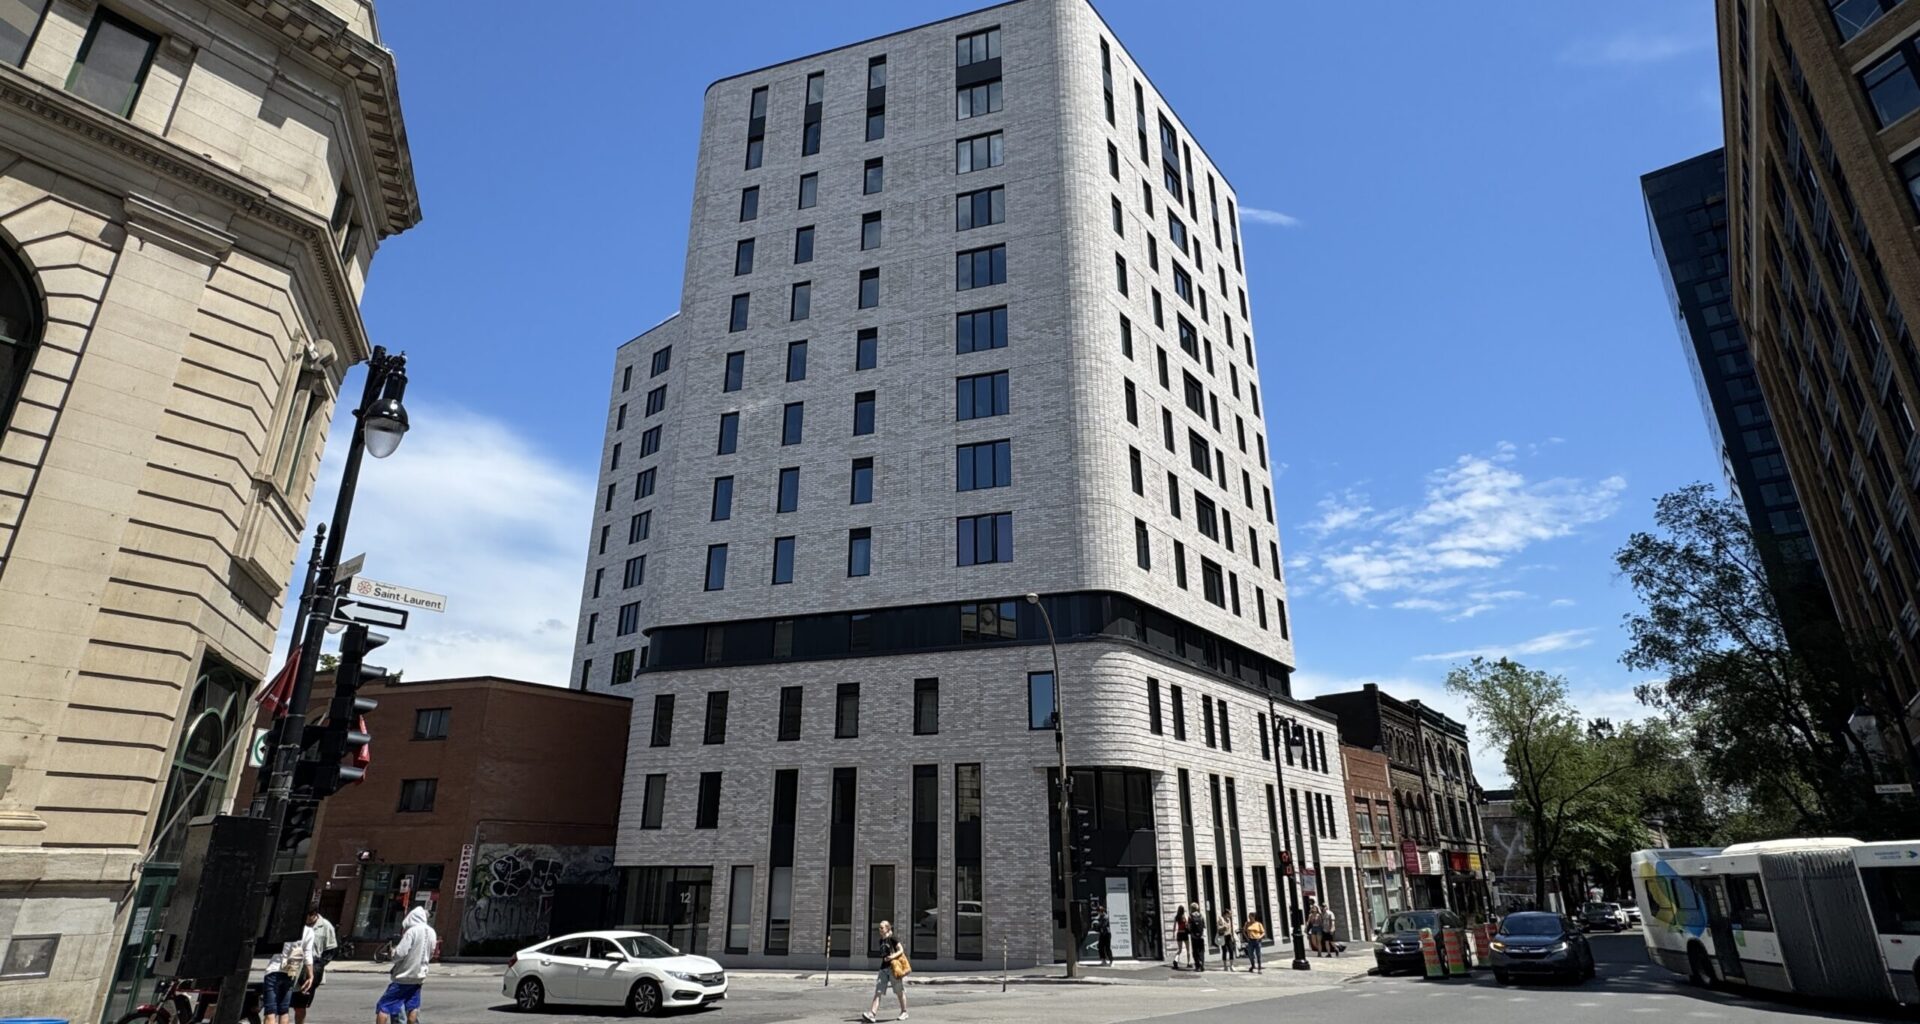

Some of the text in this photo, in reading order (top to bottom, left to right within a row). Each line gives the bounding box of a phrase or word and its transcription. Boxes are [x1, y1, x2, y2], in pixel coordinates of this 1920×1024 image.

[373, 587, 442, 609] Saint-Laurent
[456, 845, 472, 896] DEPANNEUR
[680, 892, 691, 904] 12
